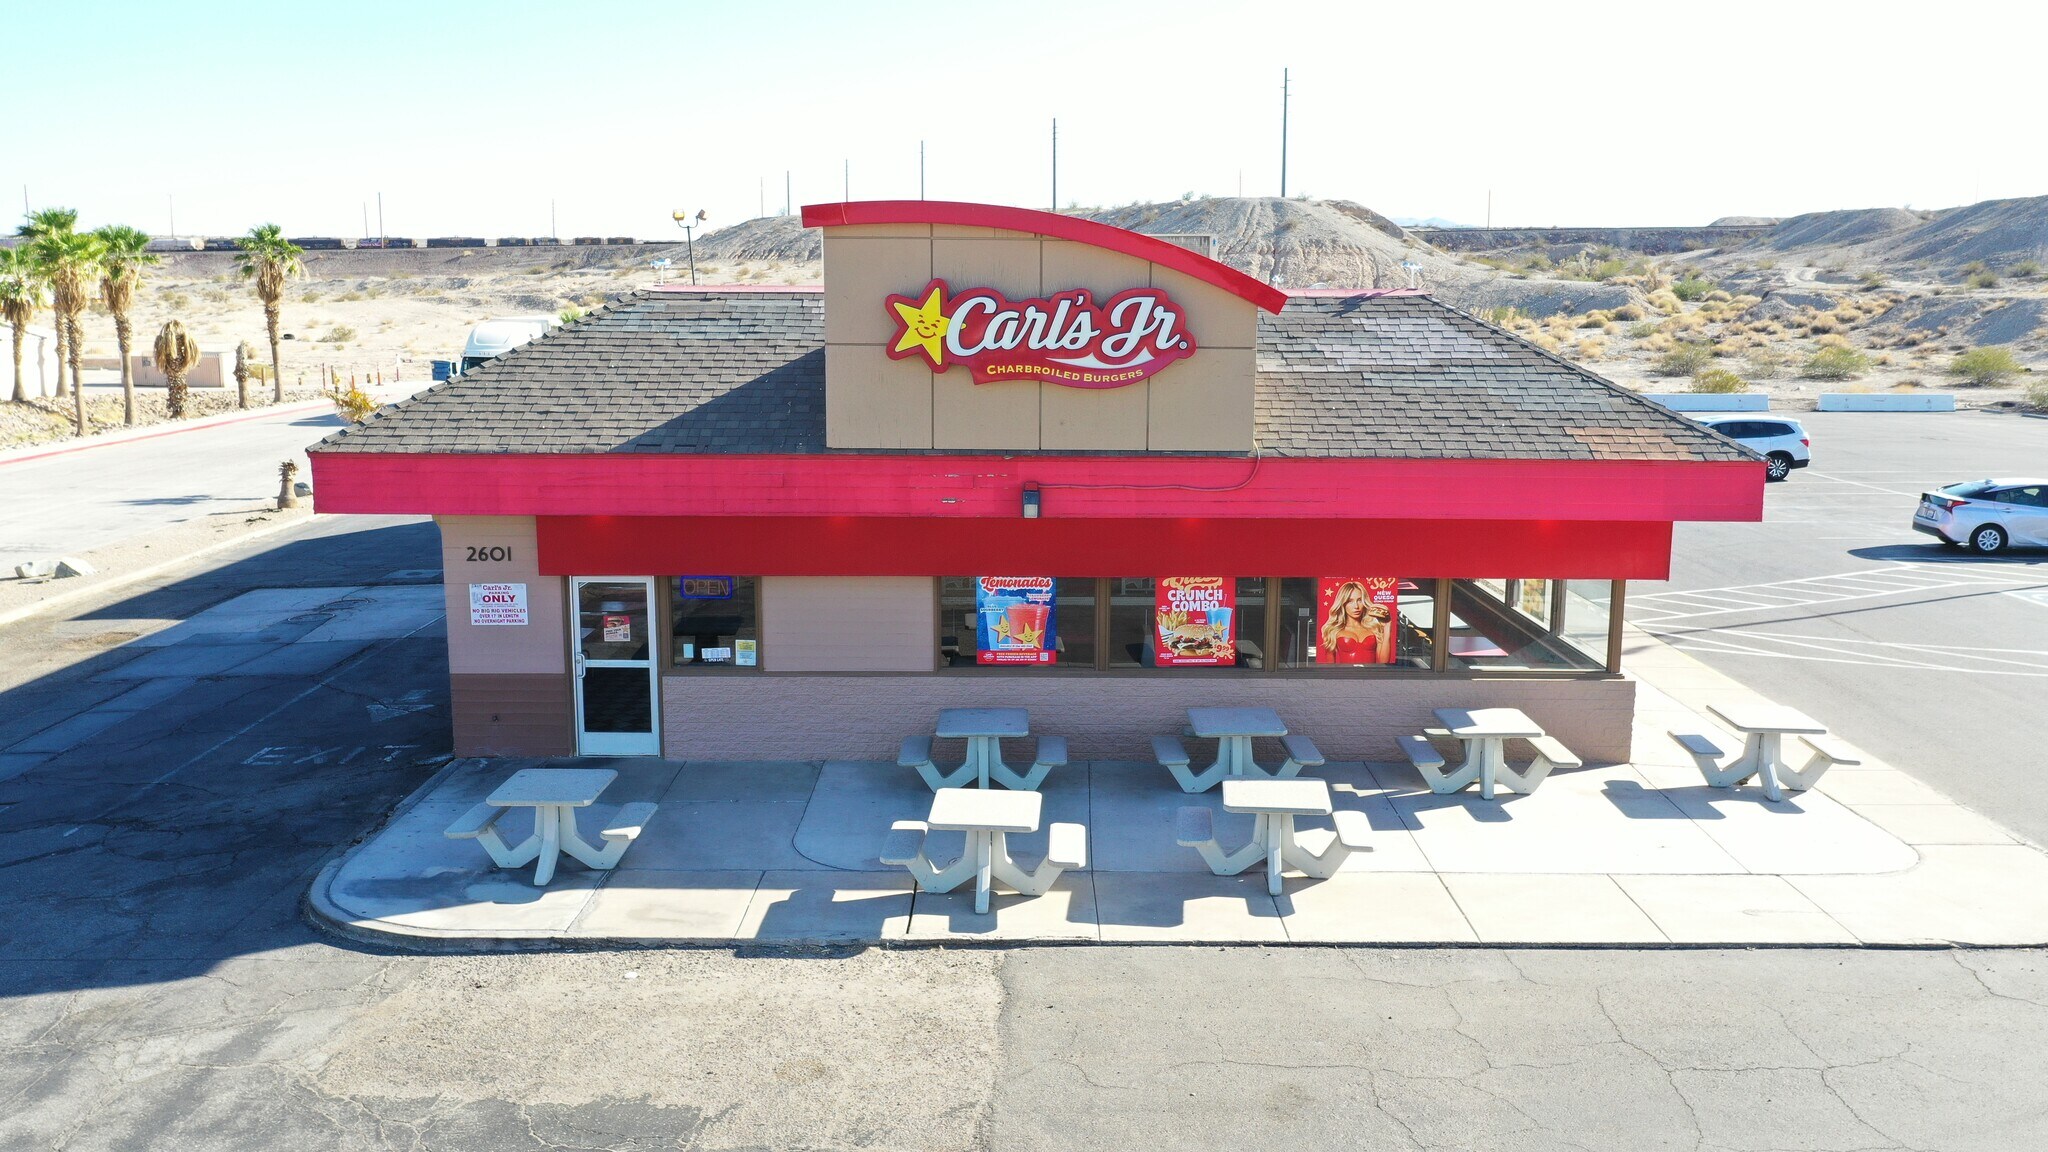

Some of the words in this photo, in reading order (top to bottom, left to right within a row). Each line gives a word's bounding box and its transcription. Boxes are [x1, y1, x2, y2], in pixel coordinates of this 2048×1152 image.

[945, 295, 1101, 357] Carl's
[986, 364, 1081, 381] CHARBROILED
[1083, 369, 1144, 383] BURGERS
[466, 546, 512, 561] 2601
[683, 580, 729, 596] OPEN
[980, 577, 1052, 591] Lemonades
[482, 594, 516, 603] ONLY
[1167, 589, 1223, 601] CRUNCH
[1171, 600, 1219, 612] COMBO
[240, 745, 421, 765] EXIT
